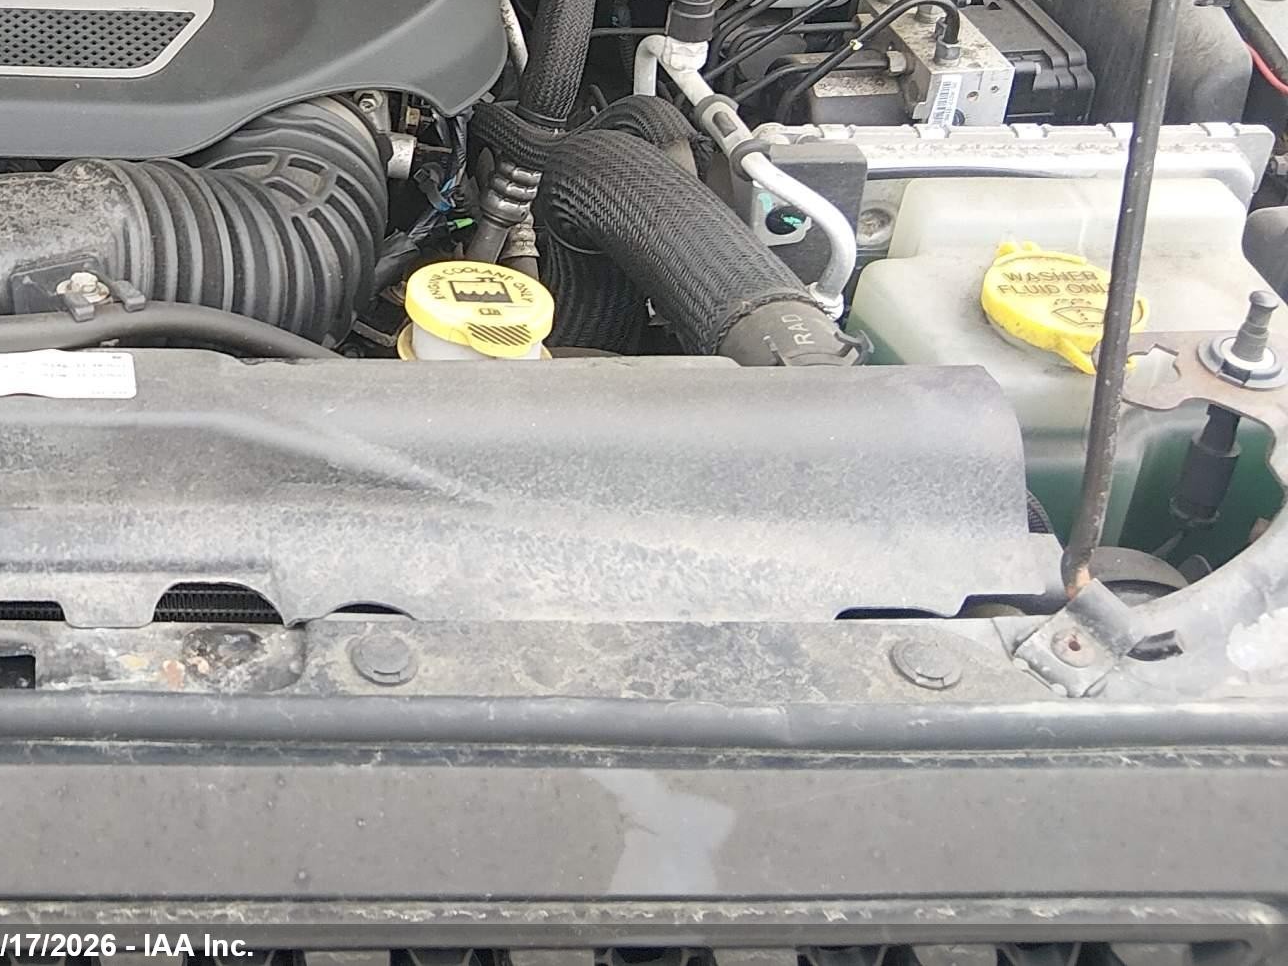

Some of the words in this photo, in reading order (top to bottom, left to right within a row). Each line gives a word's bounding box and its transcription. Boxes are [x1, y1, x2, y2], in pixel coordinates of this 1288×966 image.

[442, 266, 515, 282] COOLANT
[512, 282, 534, 303] ONLY
[1001, 270, 1099, 283] WASHER
[997, 284, 1060, 295] FLUID
[1065, 283, 1112, 294] ONL
[780, 314, 815, 345] RAD
